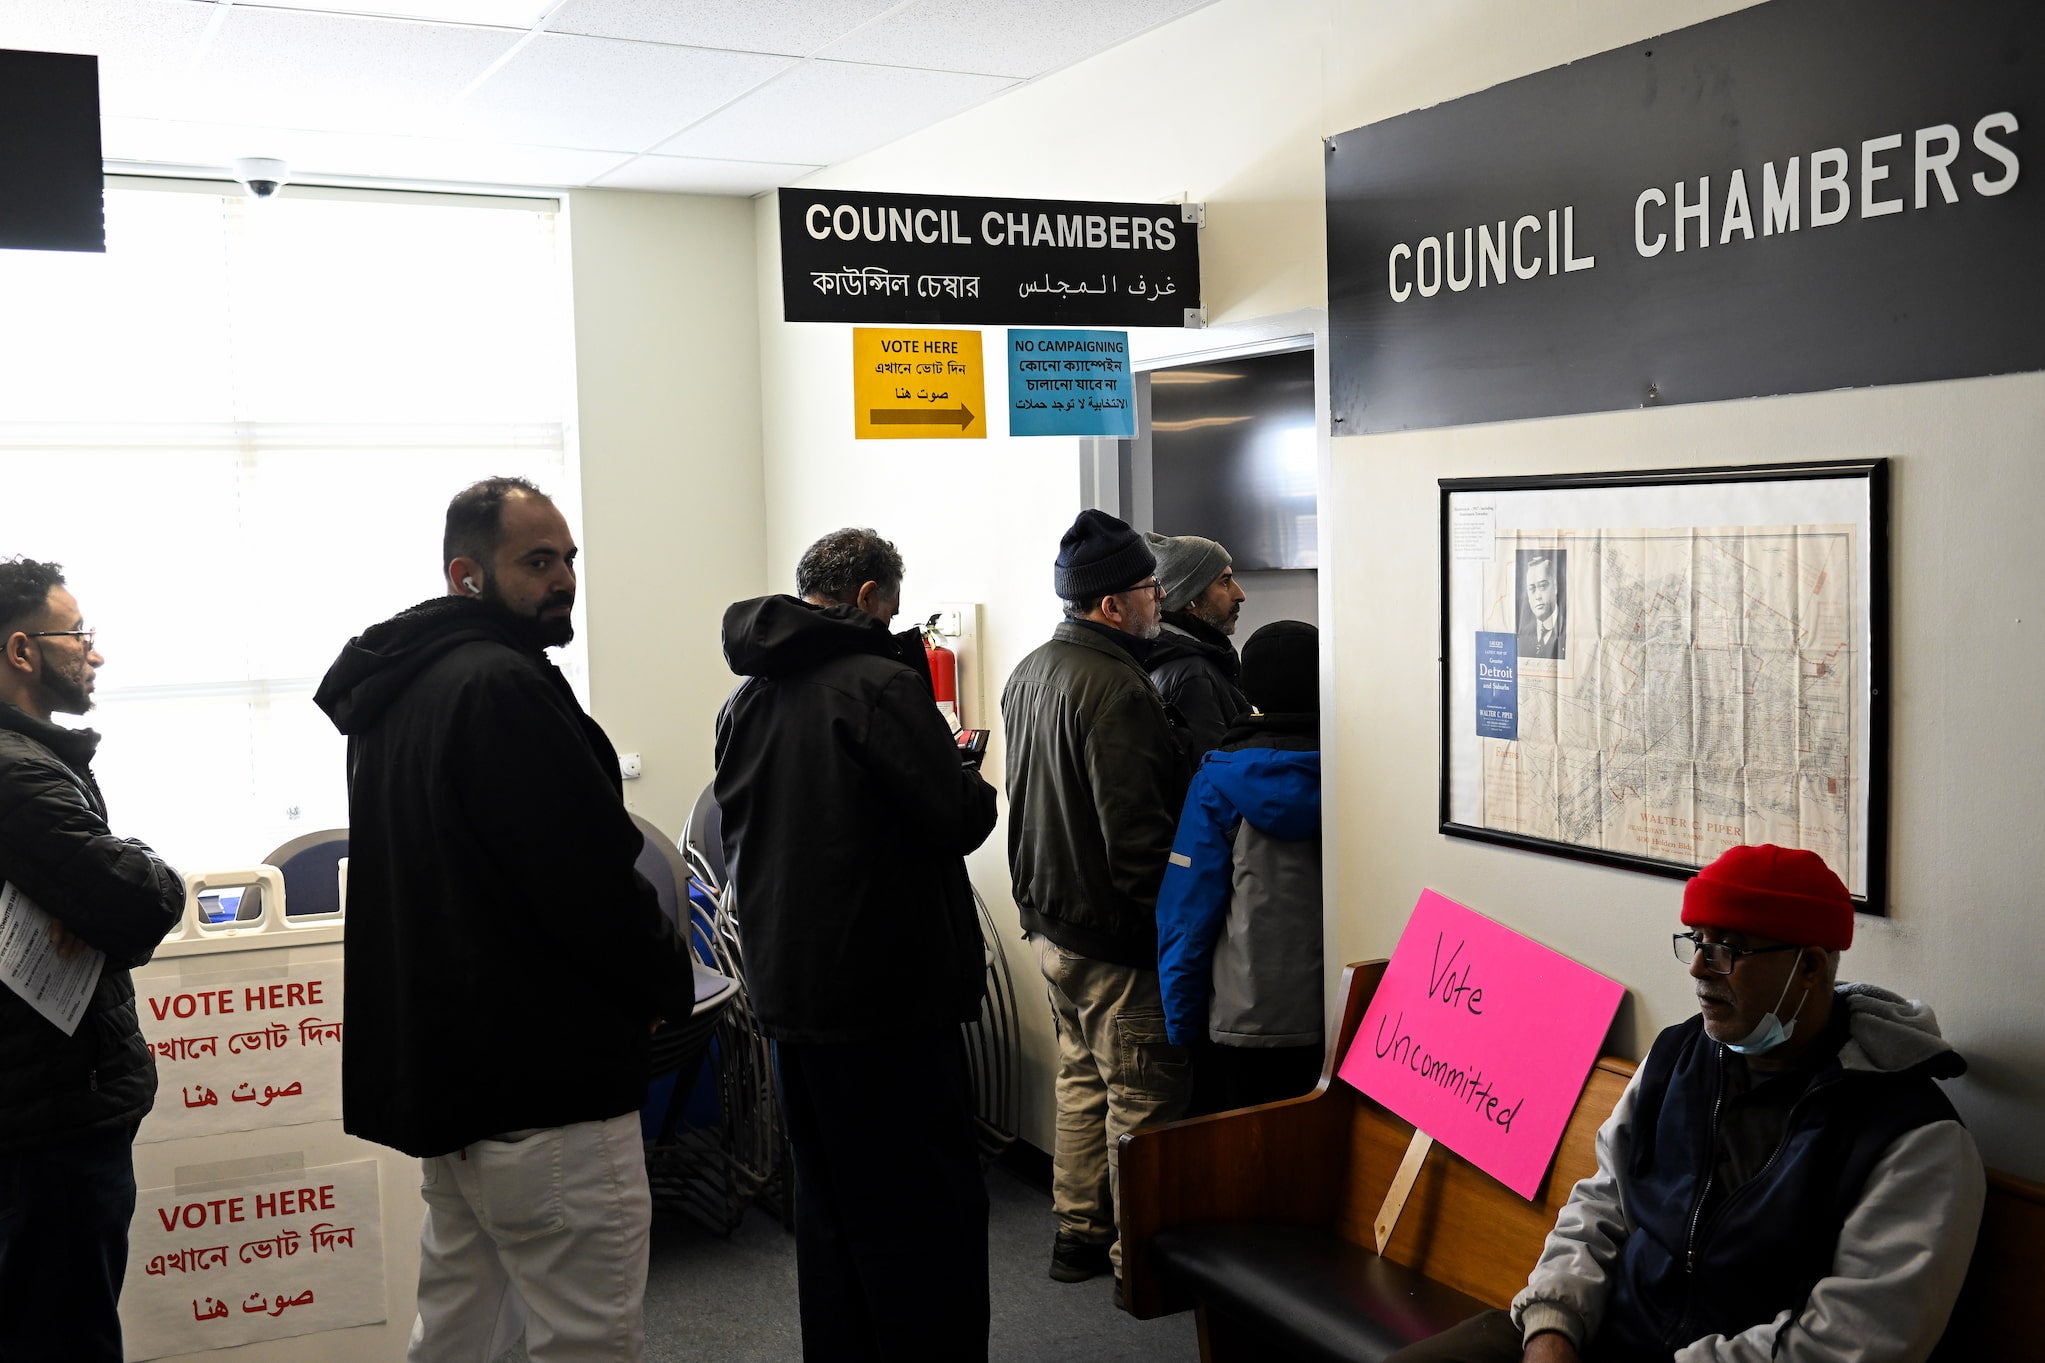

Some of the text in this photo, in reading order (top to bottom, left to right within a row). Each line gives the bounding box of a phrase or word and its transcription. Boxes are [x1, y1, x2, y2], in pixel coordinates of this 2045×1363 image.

[1389, 113, 2018, 302] COUNCIL CHAMBERS
[806, 204, 1175, 250] COUNCIL CHAMBERS
[810, 266, 980, 298] কাউন্সিল চেম্বার
[1019, 274, 1175, 301] غرف المجلس
[881, 340, 958, 353] VOTE HERE
[1016, 341, 1123, 352] NO CAMPAIGNING
[875, 360, 967, 375] এখানে ভোট দিন
[1019, 360, 1061, 372] কোনো
[895, 387, 949, 403] صوت هنا
[1026, 379, 1073, 391] চালানো
[1103, 379, 1118, 391] না
[1015, 399, 1048, 409] حملات
[1052, 399, 1075, 412] توجد
[1077, 398, 1085, 409] لا
[1479, 663, 1513, 679] Detroit
[1640, 813, 1687, 828] WALTER
[1707, 822, 1741, 836] PIPER
[1428, 931, 1482, 1015] Vote
[148, 981, 323, 1021] VOTE HERE
[228, 1023, 289, 1054] ভোট
[298, 1017, 342, 1046] দিন
[1375, 1012, 1524, 1134] Uncommitted
[182, 1081, 302, 1108] صوت هنا
[158, 1185, 335, 1231] VOTE HERE
[146, 1224, 352, 1274] এখানে ভোট দিন
[193, 1290, 314, 1320] صوت هنا
